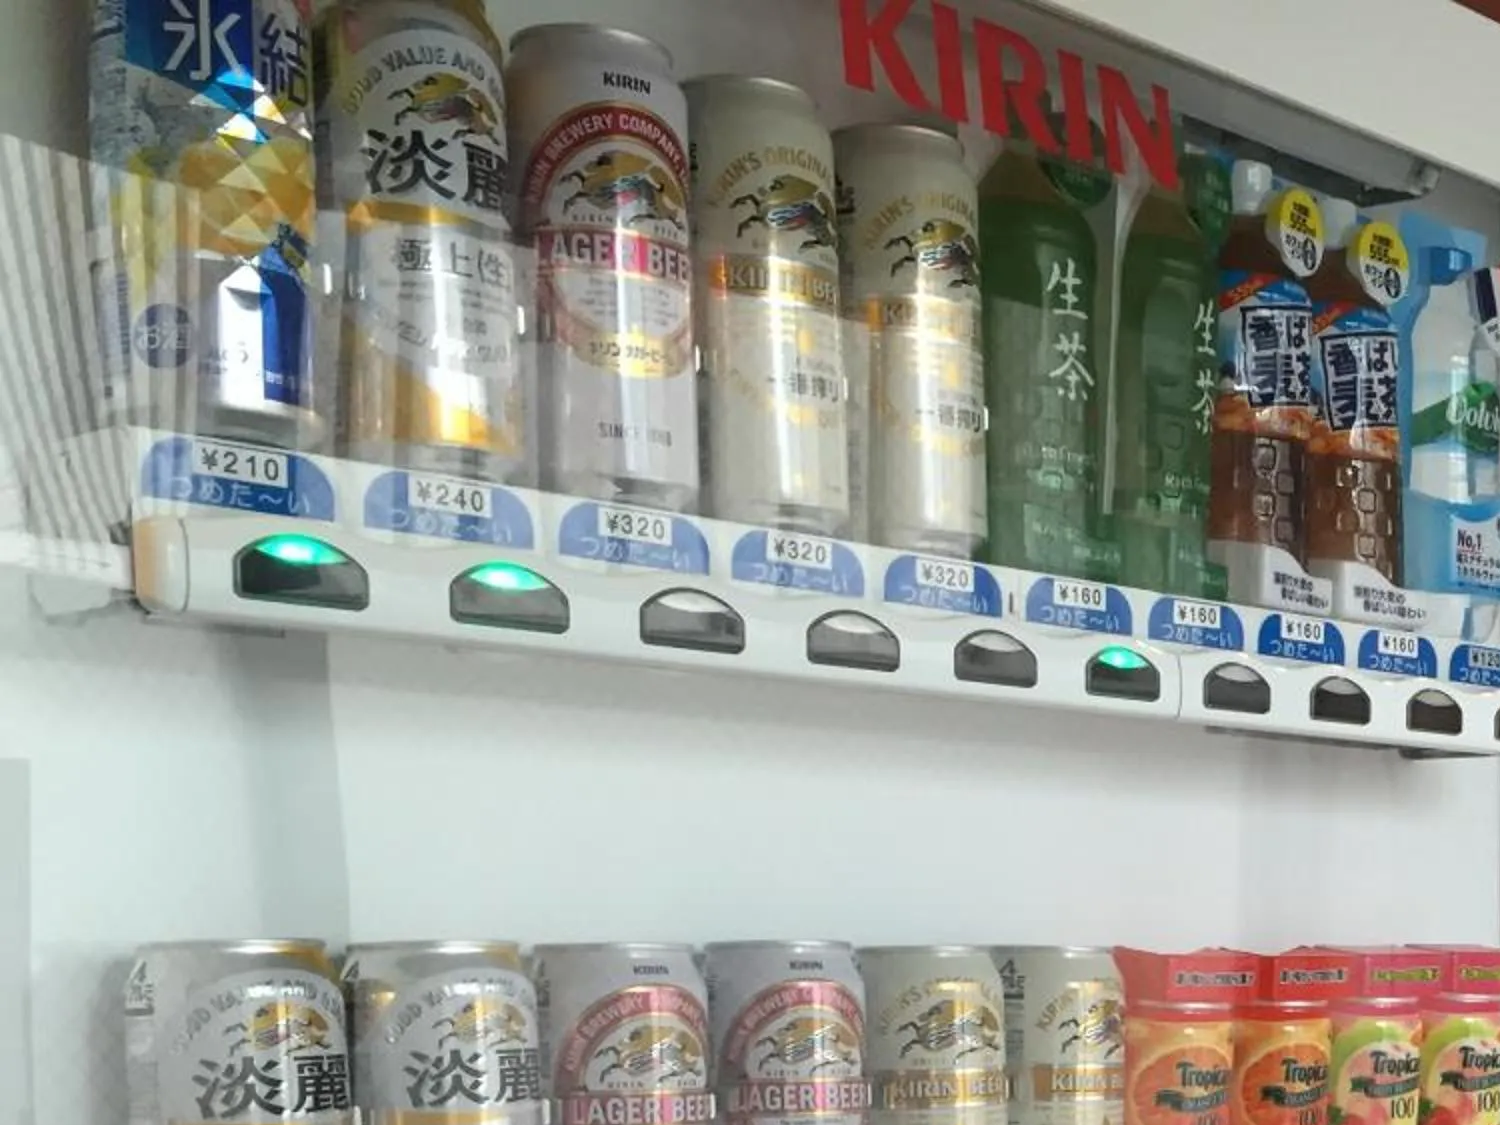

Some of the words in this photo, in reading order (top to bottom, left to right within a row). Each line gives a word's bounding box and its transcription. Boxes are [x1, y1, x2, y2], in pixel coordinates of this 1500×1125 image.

[160, 0, 311, 107] 氷結
[602, 70, 652, 96] KIRIN
[839, 0, 1180, 192] KIRIN
[357, 128, 507, 210] 淡麗
[1046, 256, 1095, 401] 生茶
[1190, 298, 1218, 435] 生茶
[200, 446, 280, 483] ¥210
[415, 478, 486, 513] ¥240
[605, 510, 667, 541] ¥320
[773, 536, 828, 565] ¥320
[922, 560, 971, 589] ¥320
[1058, 583, 1102, 606] ¥160
[1176, 604, 1219, 626] ¥160
[1284, 620, 1323, 643] ¥160
[1382, 635, 1416, 657] ¥160
[191, 1053, 351, 1120] 淡麗
[401, 1048, 543, 1108] 淡麗
[735, 1086, 820, 1113] LAGER
[825, 1084, 871, 1110] BEER
[1389, 1099, 1416, 1120] 100
